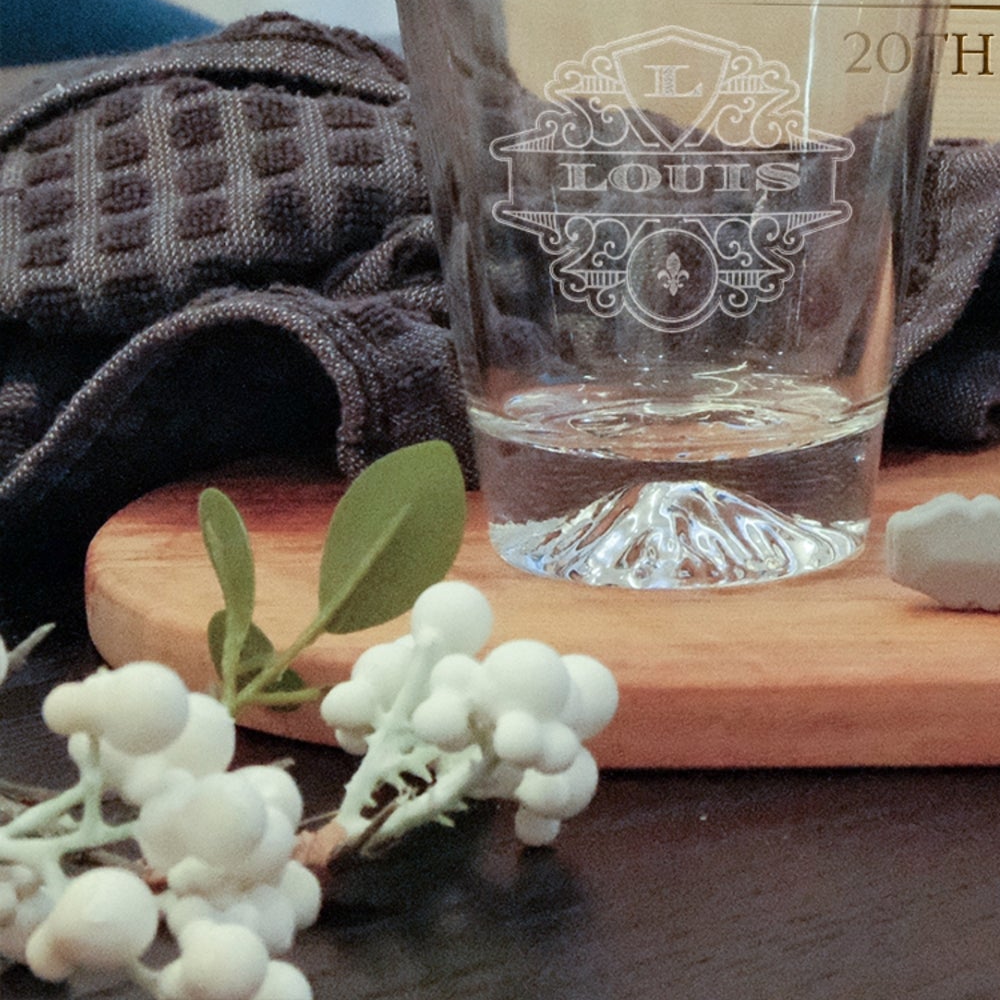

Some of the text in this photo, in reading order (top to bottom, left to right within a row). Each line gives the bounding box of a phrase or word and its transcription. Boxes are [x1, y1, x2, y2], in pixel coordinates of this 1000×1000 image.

[843, 31, 993, 77] 20TH
[643, 64, 703, 98] L
[559, 162, 801, 193] LOUIS
